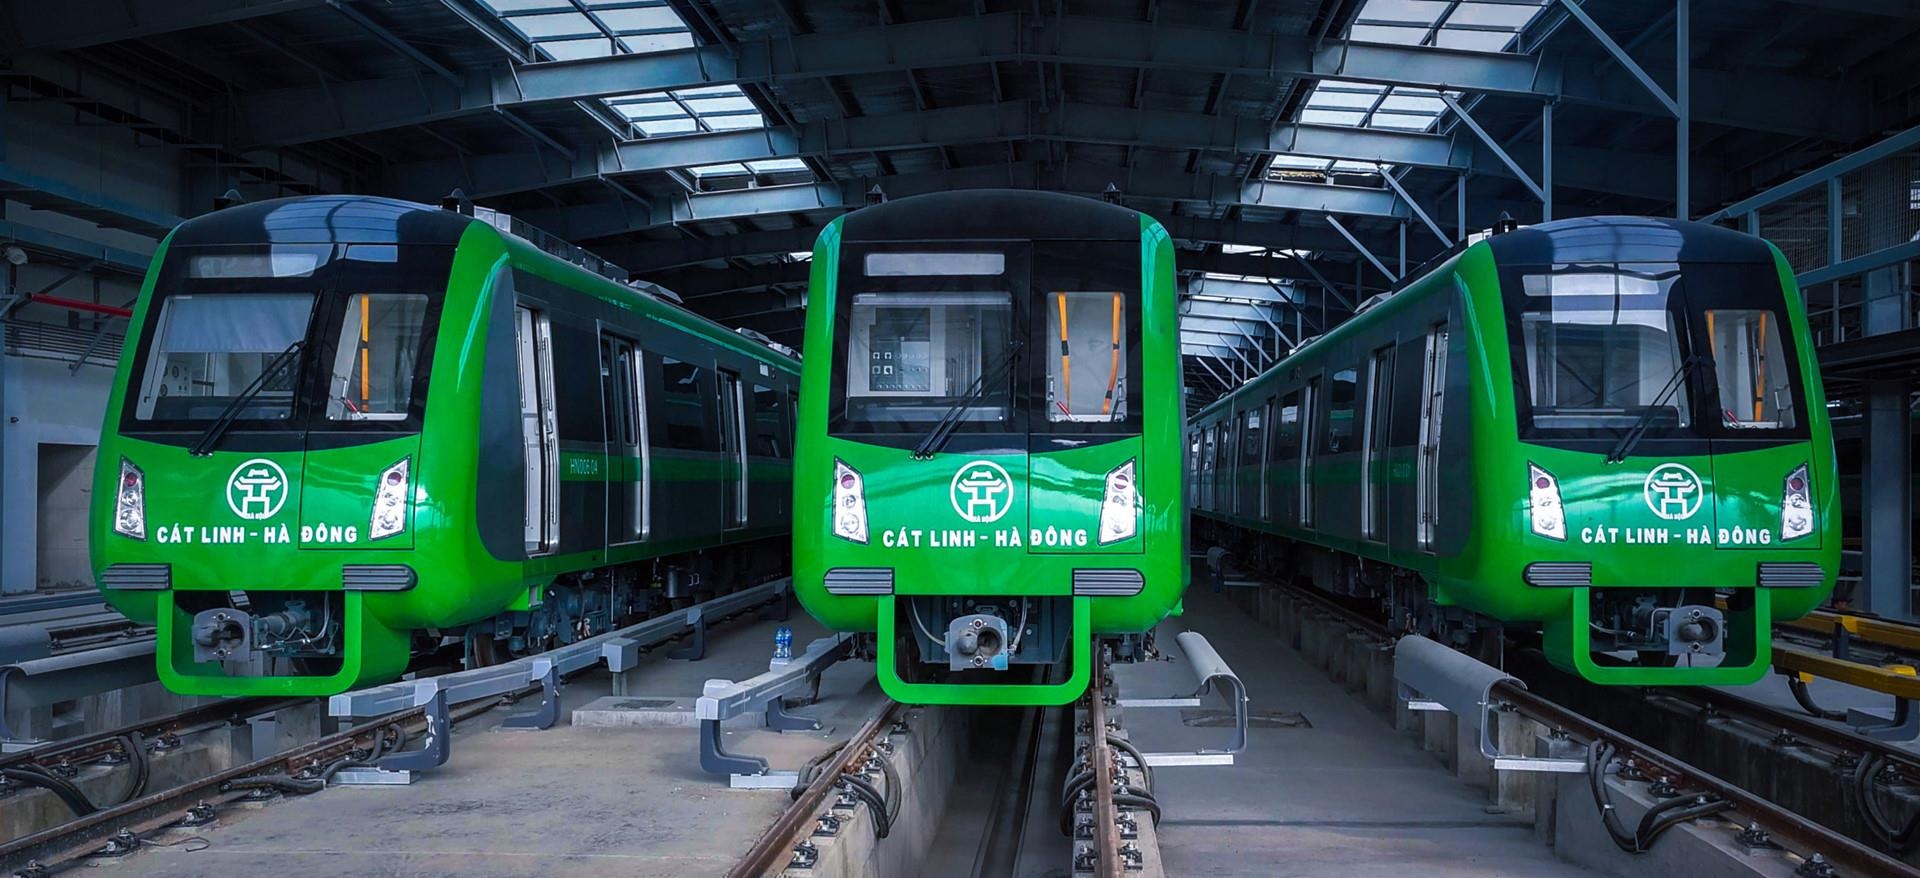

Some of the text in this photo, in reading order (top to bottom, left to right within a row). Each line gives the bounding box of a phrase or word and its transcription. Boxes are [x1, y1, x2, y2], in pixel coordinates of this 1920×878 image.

[157, 524, 194, 543] CÁT
[202, 527, 244, 543] LINH
[264, 524, 289, 543] HÀ
[301, 523, 356, 542] ĐÔNG
[883, 527, 922, 547] CÁT
[931, 531, 975, 546] LINH
[996, 527, 1021, 546] HÀ
[1030, 526, 1087, 546] ĐÔNG
[1582, 525, 1618, 543] CÁT
[1626, 528, 1667, 543] LINH
[1687, 526, 1711, 543] HÀ
[1719, 526, 1770, 544] ĐÔNG
